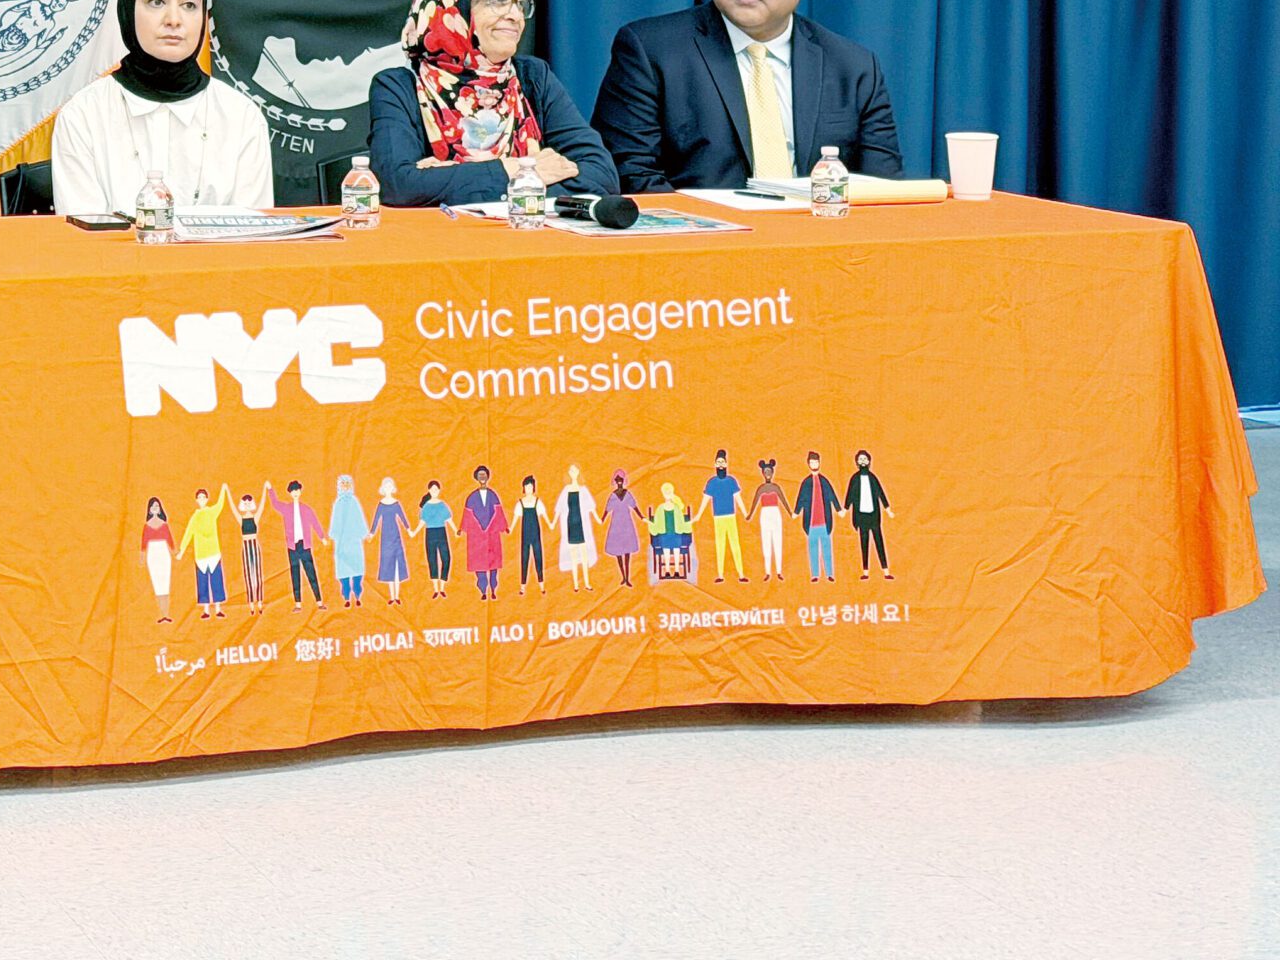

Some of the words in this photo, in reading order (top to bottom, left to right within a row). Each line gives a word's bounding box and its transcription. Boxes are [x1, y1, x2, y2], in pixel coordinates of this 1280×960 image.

[415, 300, 515, 341] Civic
[527, 287, 794, 345] Engagement
[119, 304, 387, 417] NYC
[419, 354, 675, 400] Commission
[216, 642, 278, 666] HELLO!
[353, 631, 414, 658] ¡HOLA!
[658, 608, 785, 631] ЗДРАВСТВУЙТЕ!
